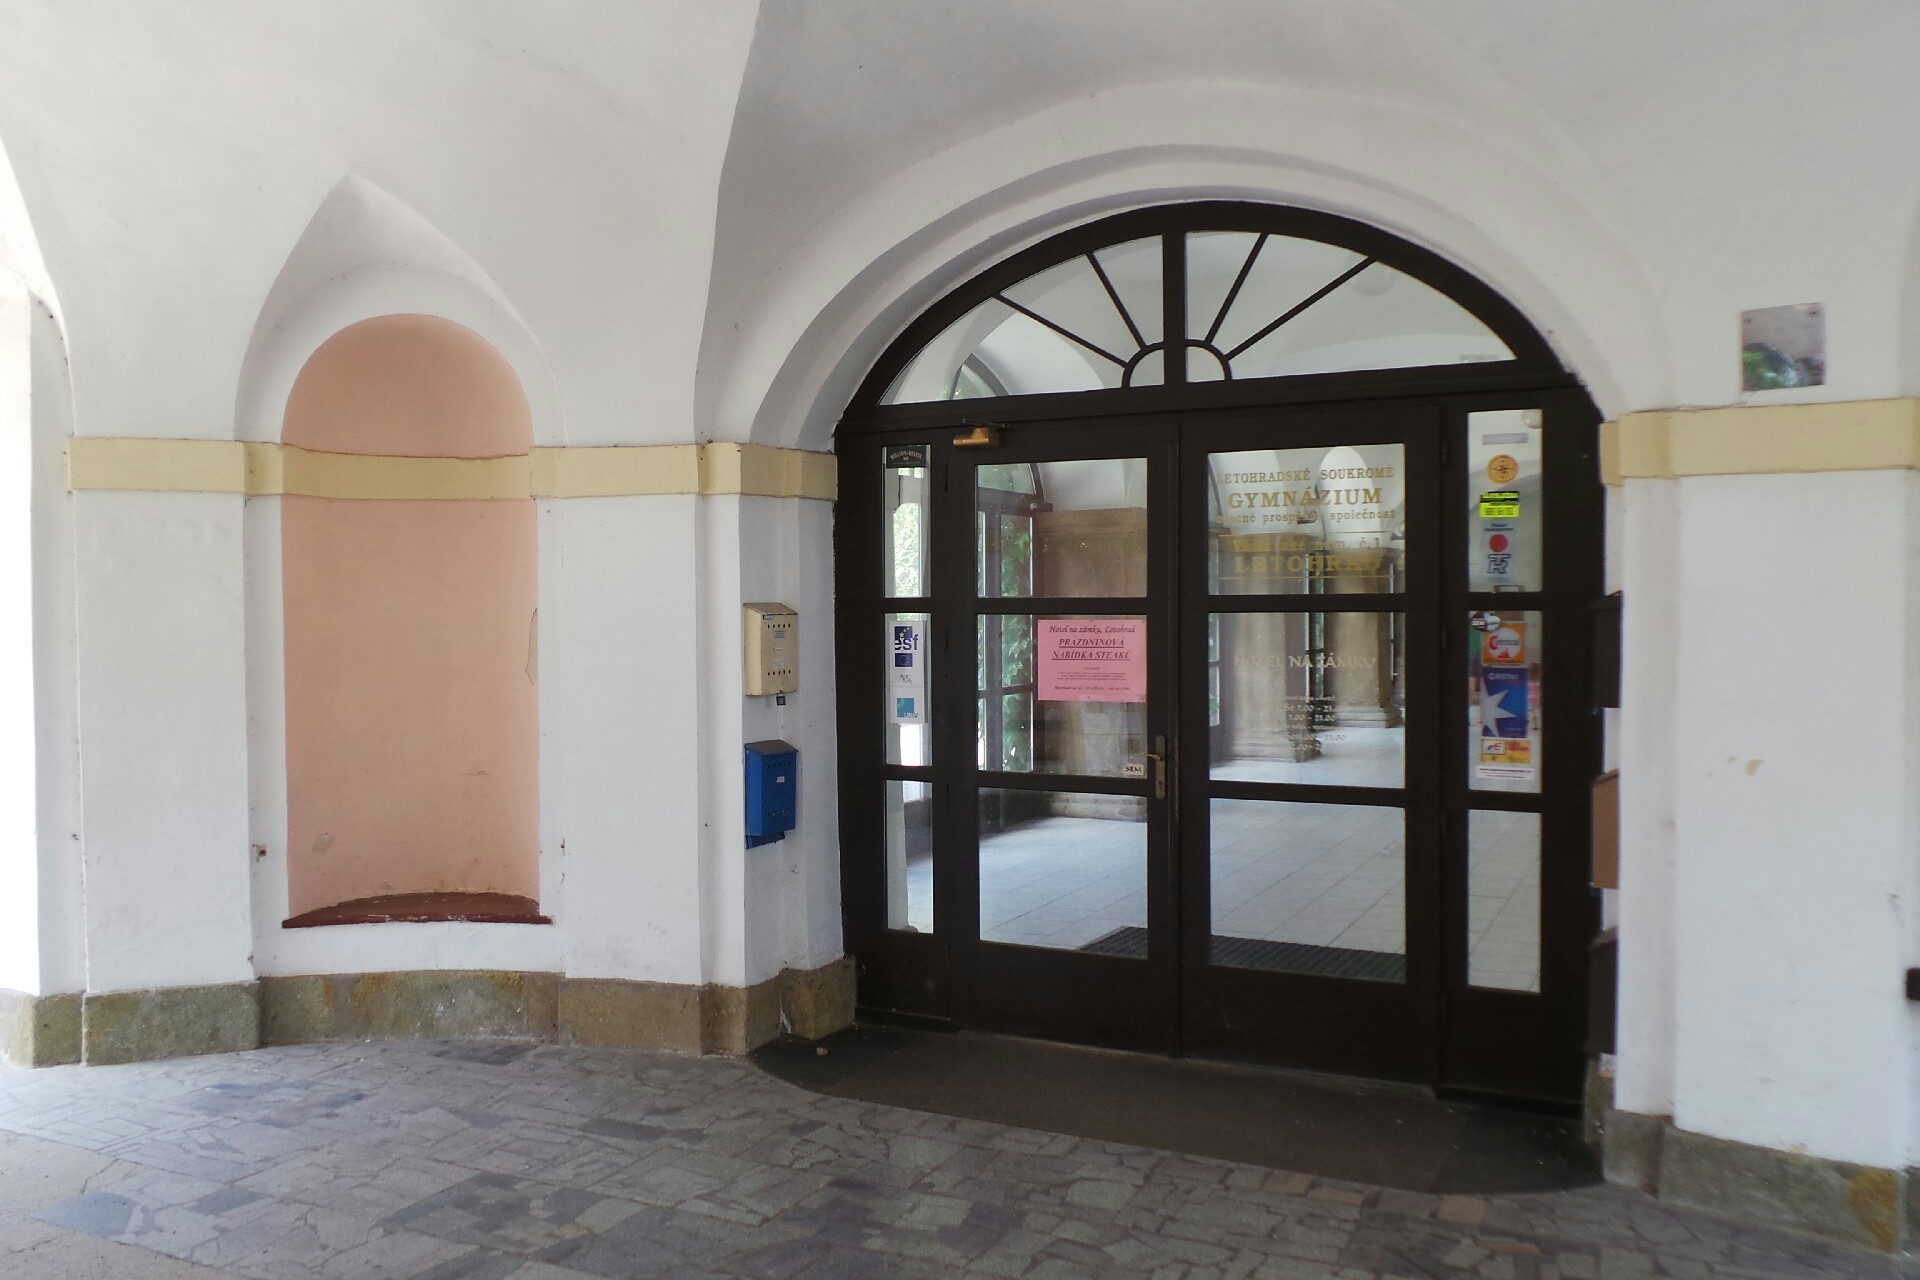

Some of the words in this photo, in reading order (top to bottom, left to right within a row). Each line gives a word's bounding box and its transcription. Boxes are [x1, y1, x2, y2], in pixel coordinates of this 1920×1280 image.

[1216, 467, 1311, 484] LETOHRADSKÉ
[1321, 464, 1394, 480] SOUKROMÉ
[1228, 486, 1383, 508] GYMNÁZIUM
[1330, 509, 1396, 523] společnost
[1049, 625, 1069, 633] Hotel
[1105, 625, 1137, 633] Letohrad
[894, 634, 918, 650] esf
[1059, 637, 1125, 646] PRÁZDNINOVÁ
[1052, 649, 1093, 659] NABÍDKA
[1288, 655, 1313, 668] NA
